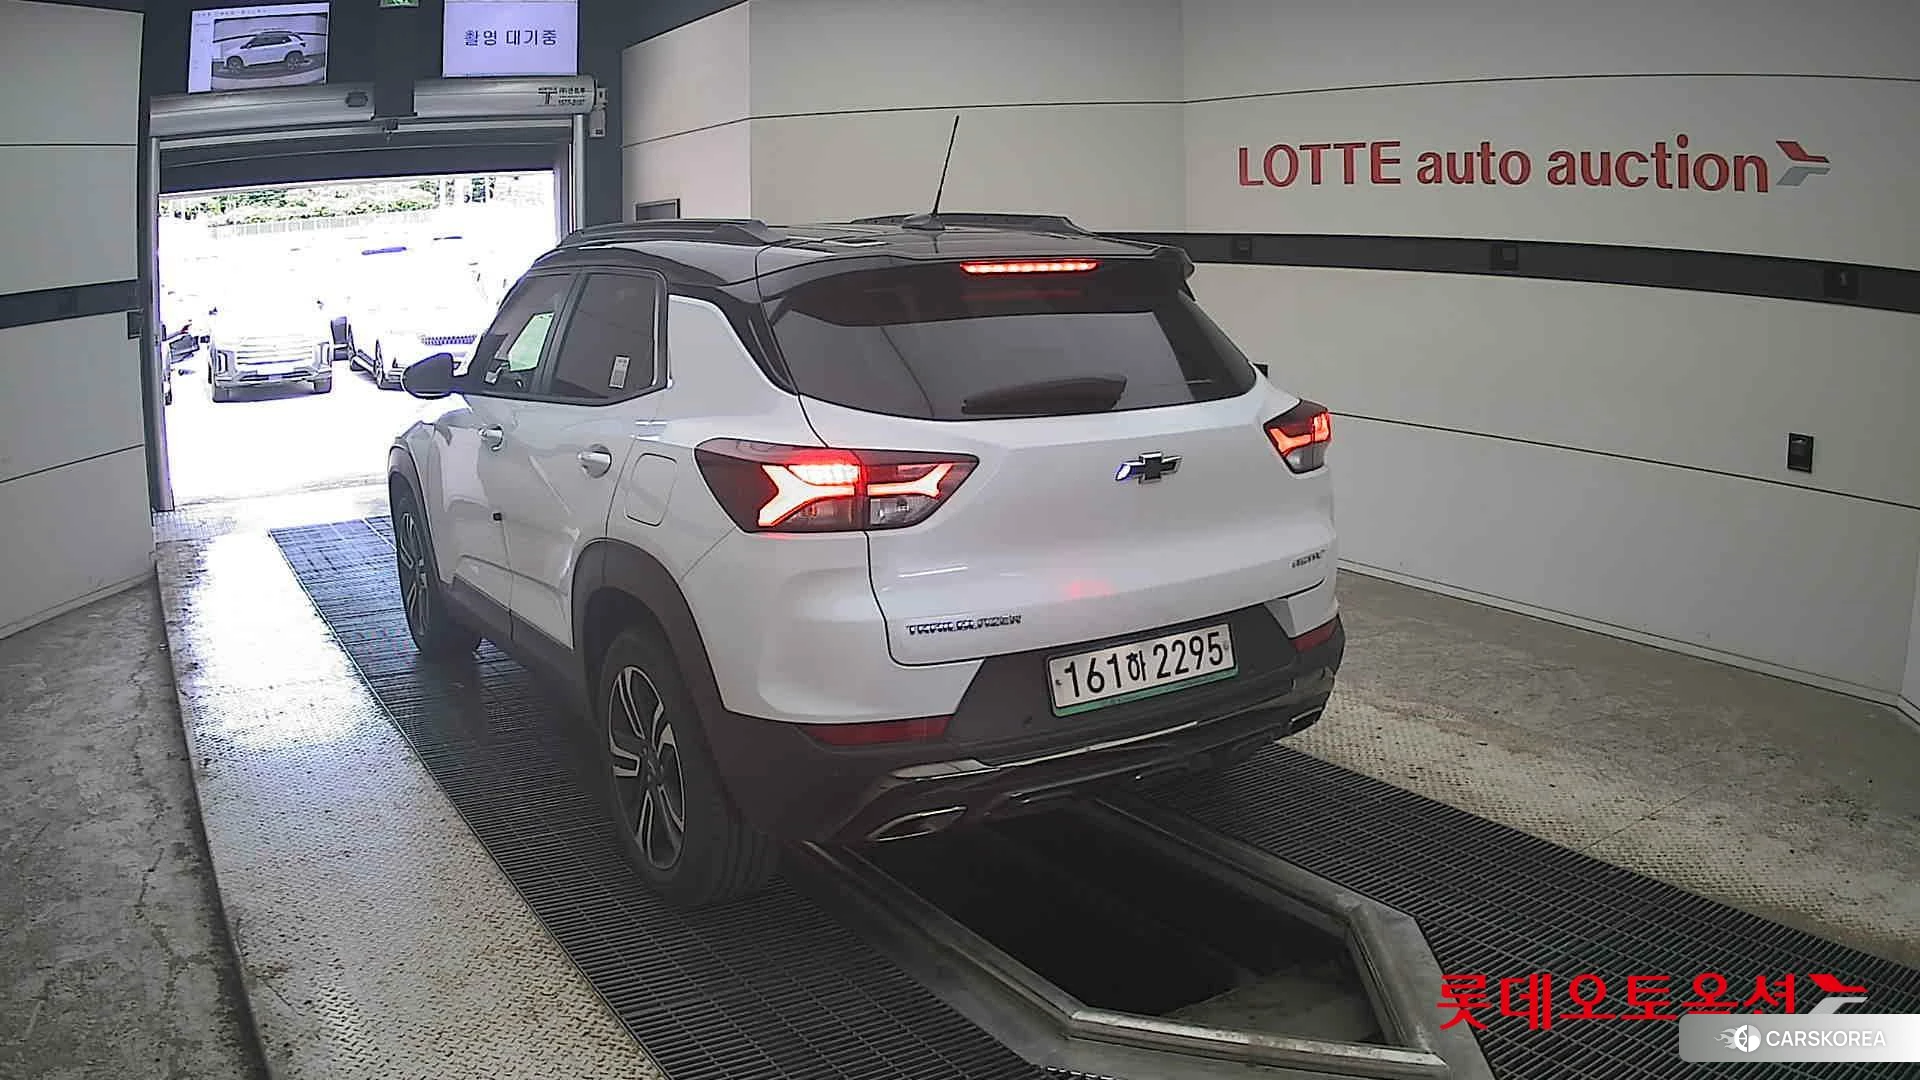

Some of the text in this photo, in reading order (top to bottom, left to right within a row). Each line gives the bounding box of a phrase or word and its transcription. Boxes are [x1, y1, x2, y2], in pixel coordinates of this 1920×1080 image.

[505, 29, 558, 46] 대기중
[1238, 134, 1769, 193] LOTTE auto auction
[1064, 631, 1224, 698] 161하 2295
